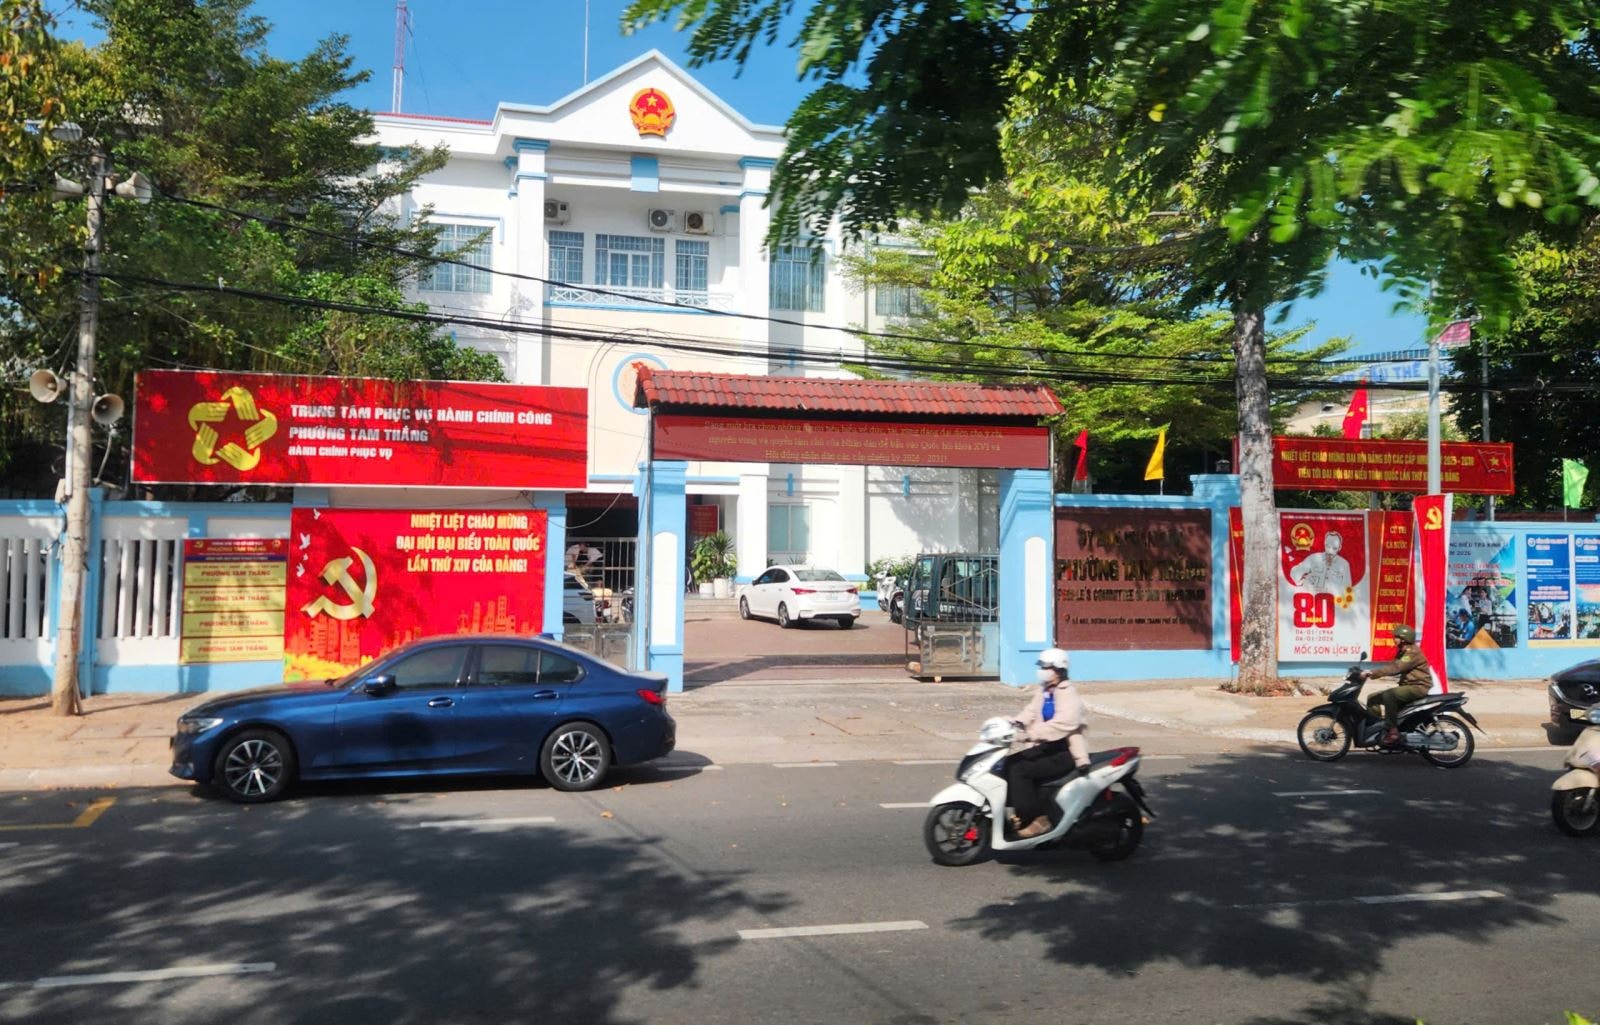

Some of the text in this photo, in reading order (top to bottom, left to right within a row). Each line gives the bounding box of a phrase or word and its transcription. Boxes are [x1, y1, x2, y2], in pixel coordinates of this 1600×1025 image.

[290, 404, 553, 425] TRUNG TÂM PHỤC VỤ HÀNH CHÍNH CÔNG
[289, 424, 429, 442] PHƯỜNG TAM THẮNG
[288, 444, 393, 460] HÀNH CHÍNH PHỤC VỤ
[1281, 450, 1298, 463] NHIỆT
[1300, 449, 1311, 463] LIỆT
[1312, 450, 1328, 463] CHÀO
[1367, 450, 1384, 464] ĐẢNG
[1393, 451, 1404, 464] CÁC
[1404, 451, 1416, 465] CẤP
[1298, 465, 1311, 478] TIẾN
[1383, 468, 1399, 481] QUỐC
[1400, 468, 1410, 481] LẦN
[410, 512, 529, 531] NHIỆT LIỆT CHÀO MỪNG
[396, 532, 540, 553] ĐẠI HỘI ĐẠI BIỂU TOÀN QUỐC
[407, 553, 528, 573] LẦN THỨ XIV CỦA ĐẢNG!
[1055, 554, 1120, 582] PHƯỜNG
[201, 569, 230, 577] PHƯỜNG
[1293, 592, 1336, 629] 80
[1294, 643, 1361, 657] MỐC SON LỊCH SỬ
